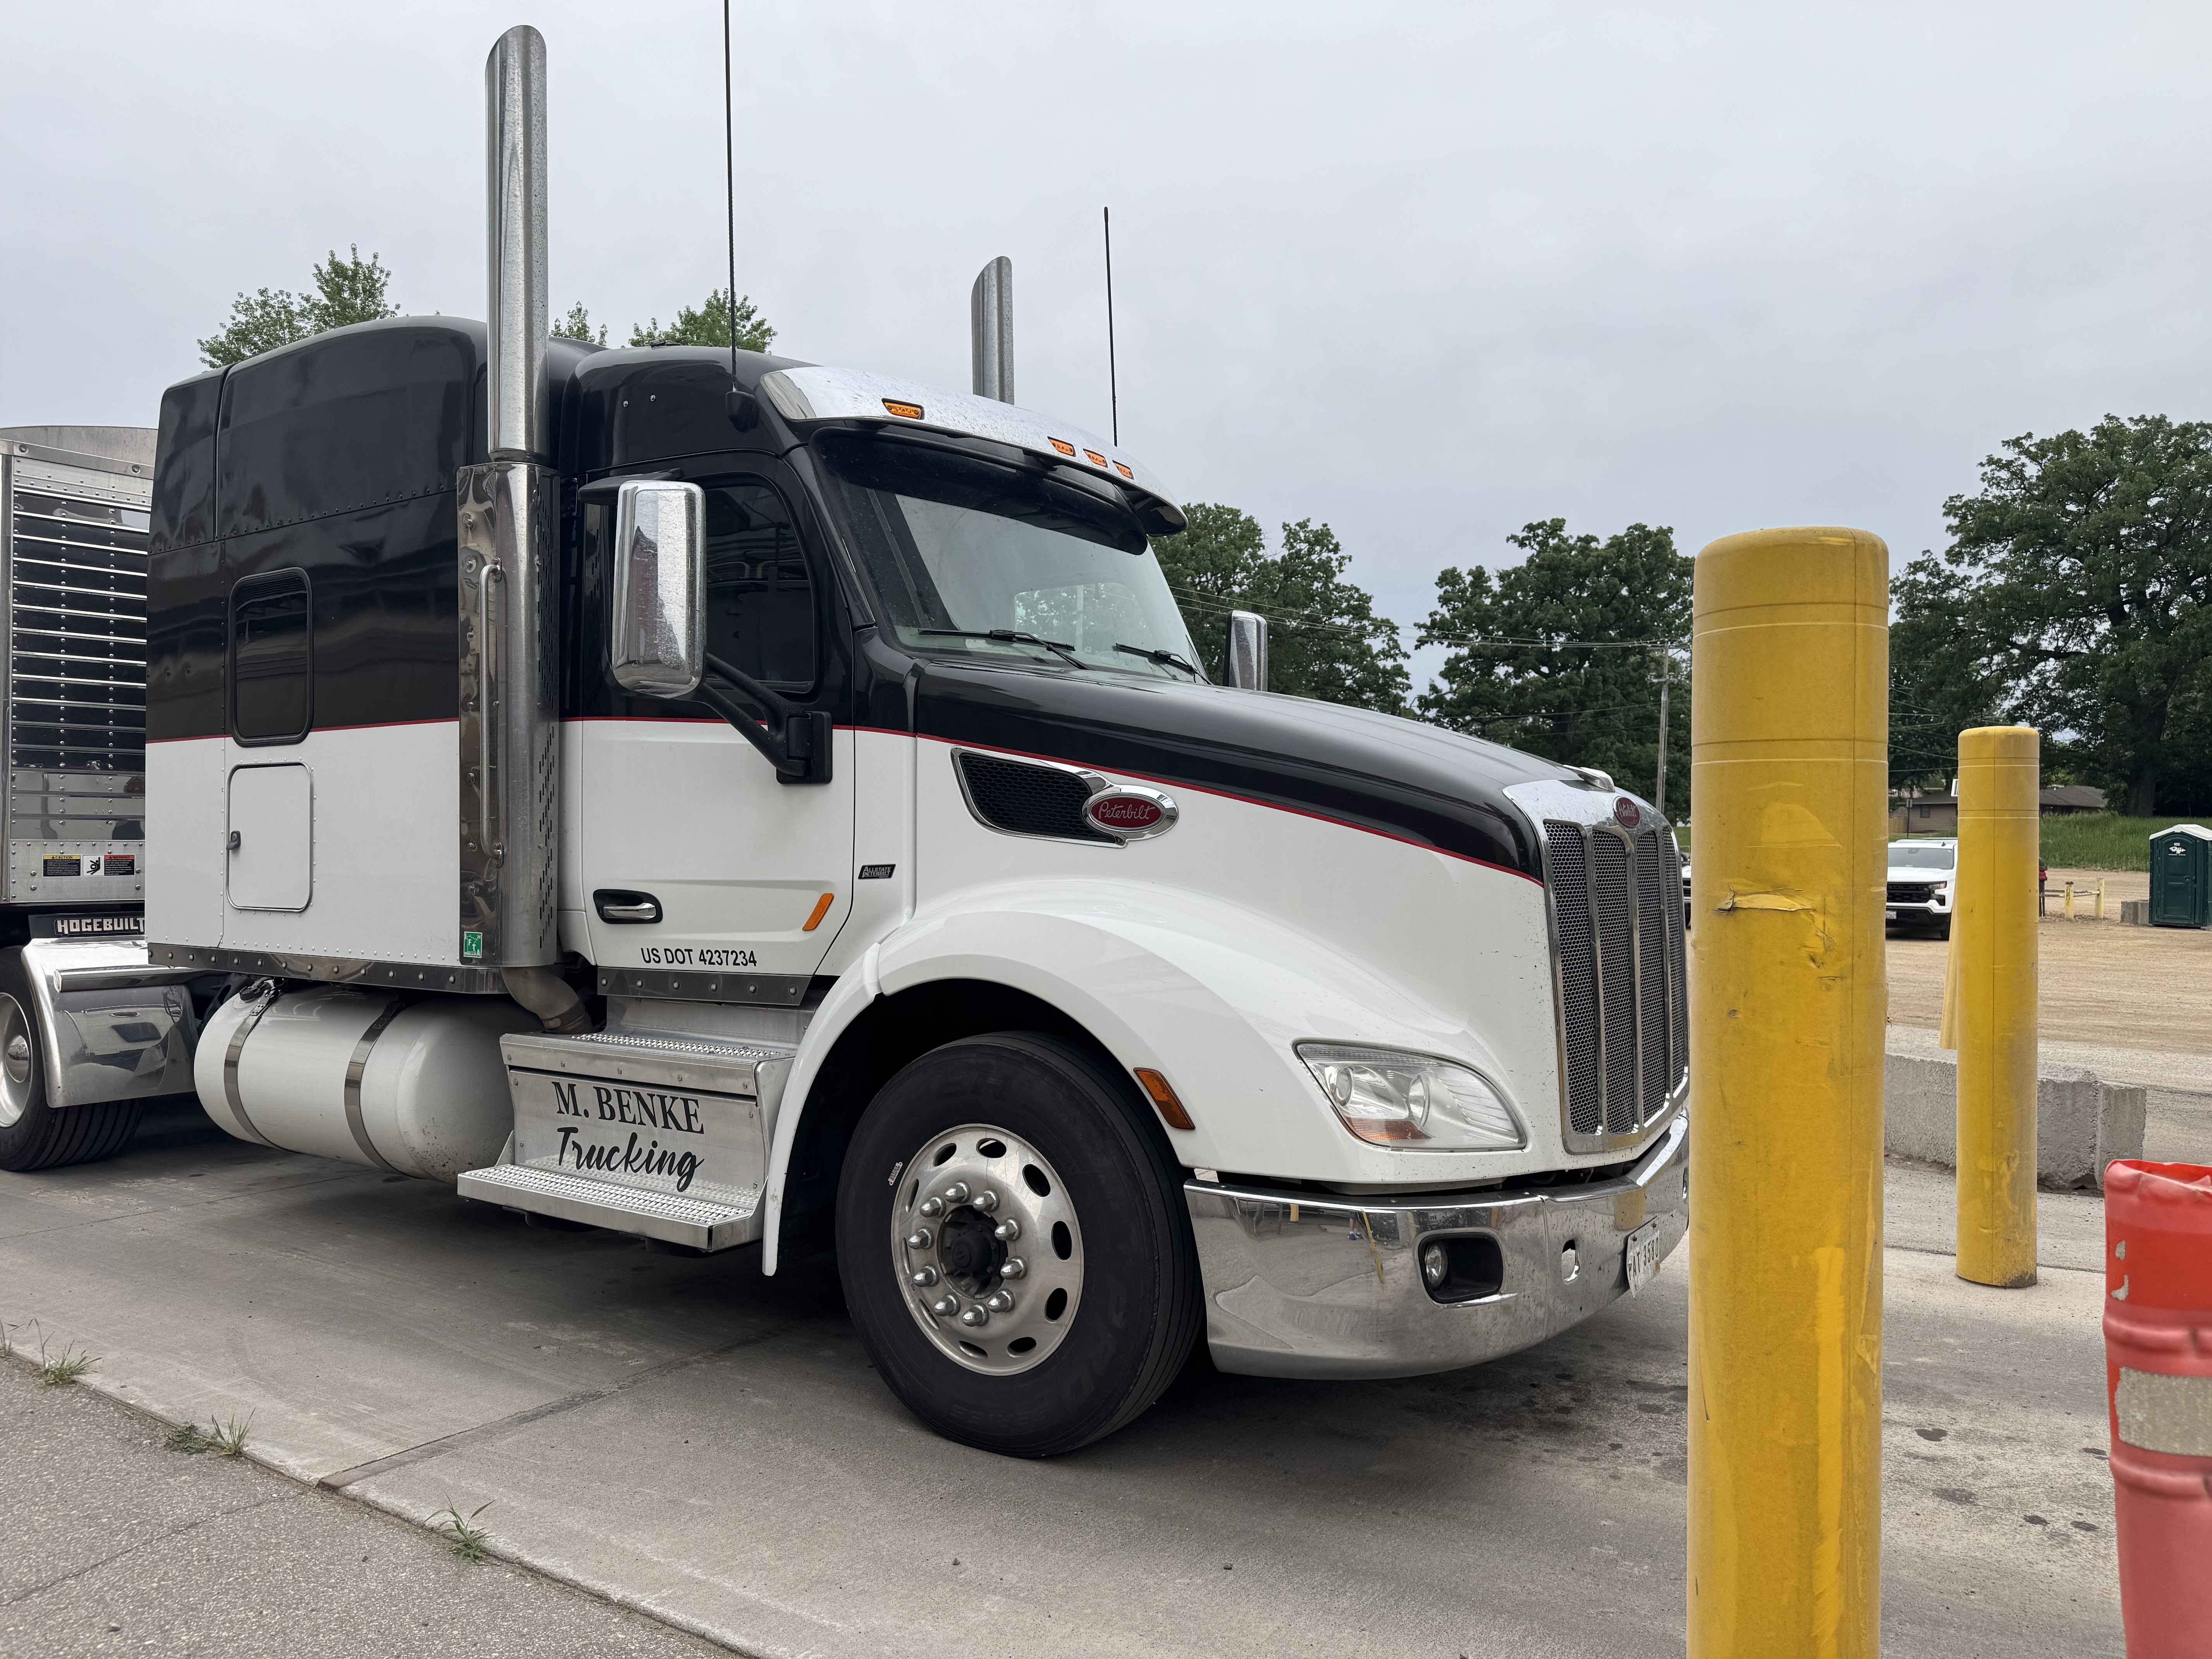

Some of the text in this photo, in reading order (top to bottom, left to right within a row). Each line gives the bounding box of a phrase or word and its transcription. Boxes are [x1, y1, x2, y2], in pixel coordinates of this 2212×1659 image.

[1098, 801, 1156, 819] Peterbilt
[57, 917, 145, 934] HOGEBUILT
[641, 948, 757, 967] US DOT 4237234
[551, 1081, 704, 1135] M. BENKE
[557, 1127, 705, 1193] Trucking
[1644, 1237, 1659, 1266] 3580
